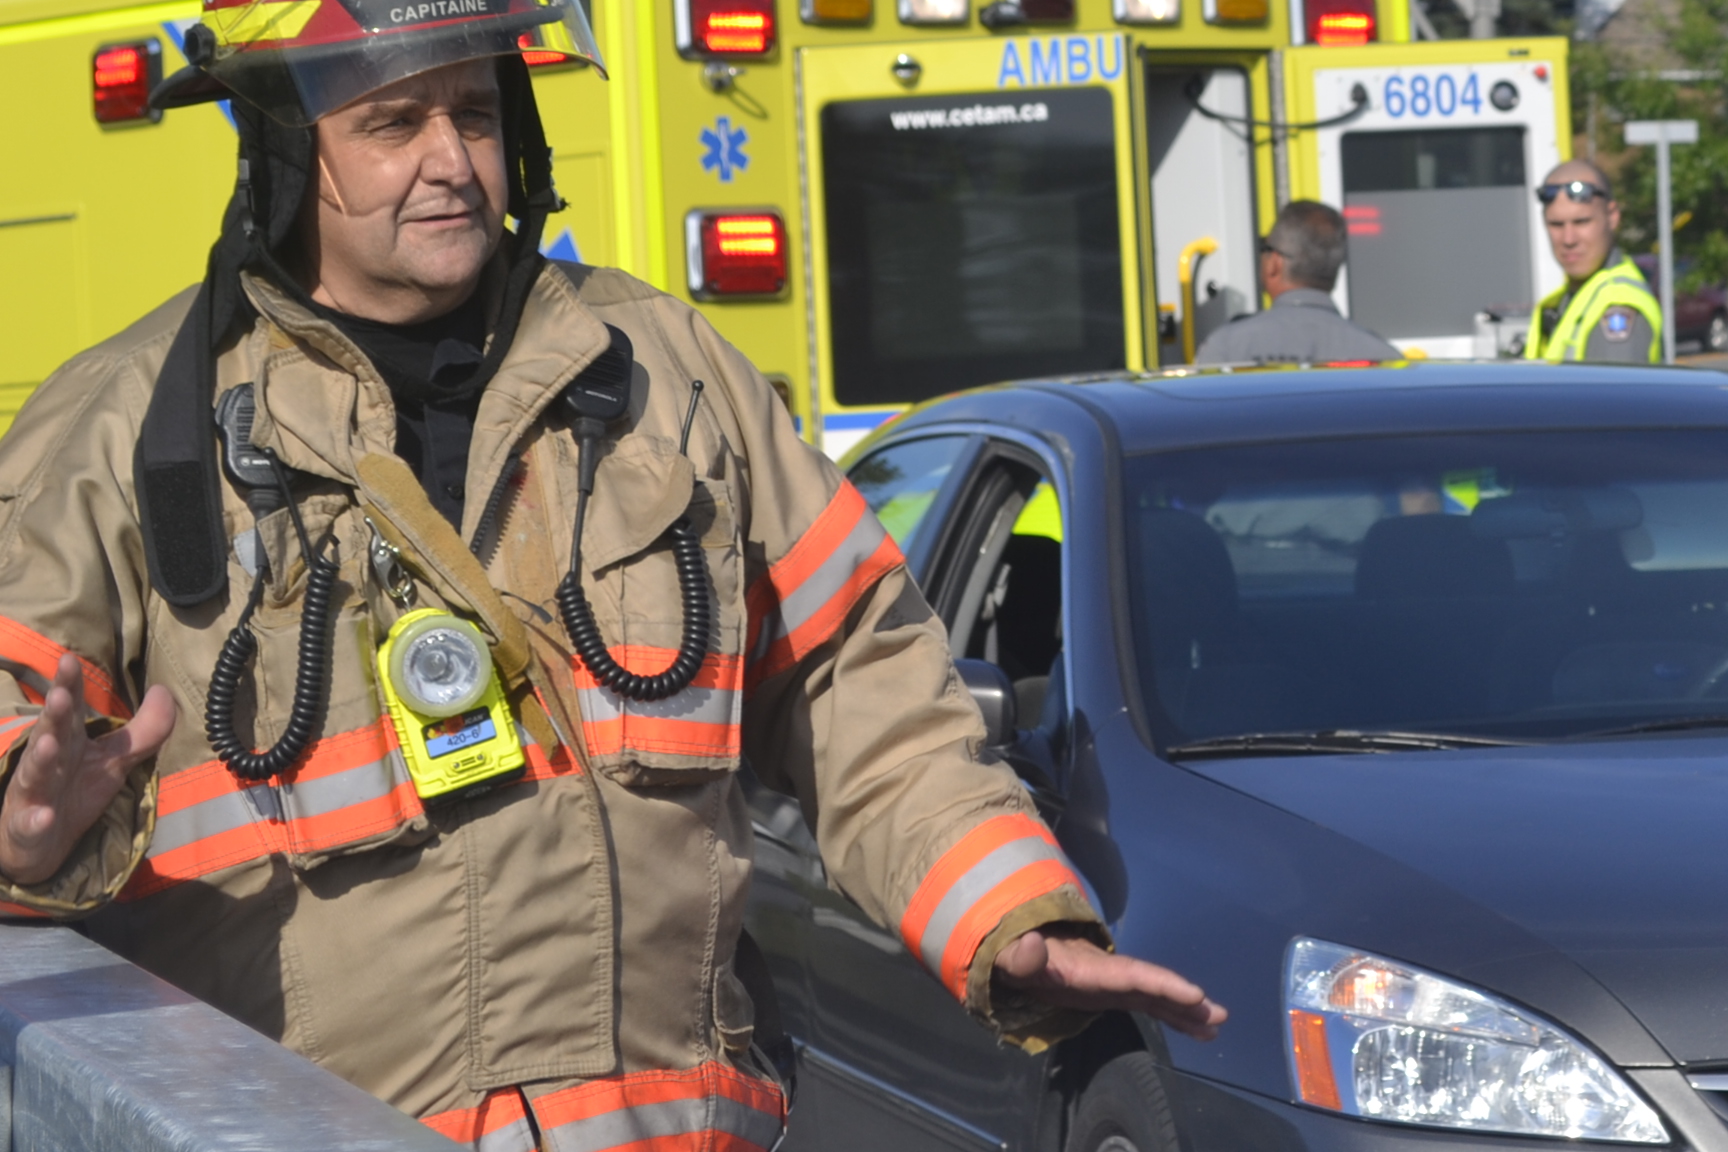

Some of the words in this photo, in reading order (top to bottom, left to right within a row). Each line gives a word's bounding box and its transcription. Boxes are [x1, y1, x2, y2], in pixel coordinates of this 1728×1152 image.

[997, 35, 1125, 89] AMBU
[890, 102, 1049, 130] www.cetam.ca
[1383, 73, 1483, 118] 6804
